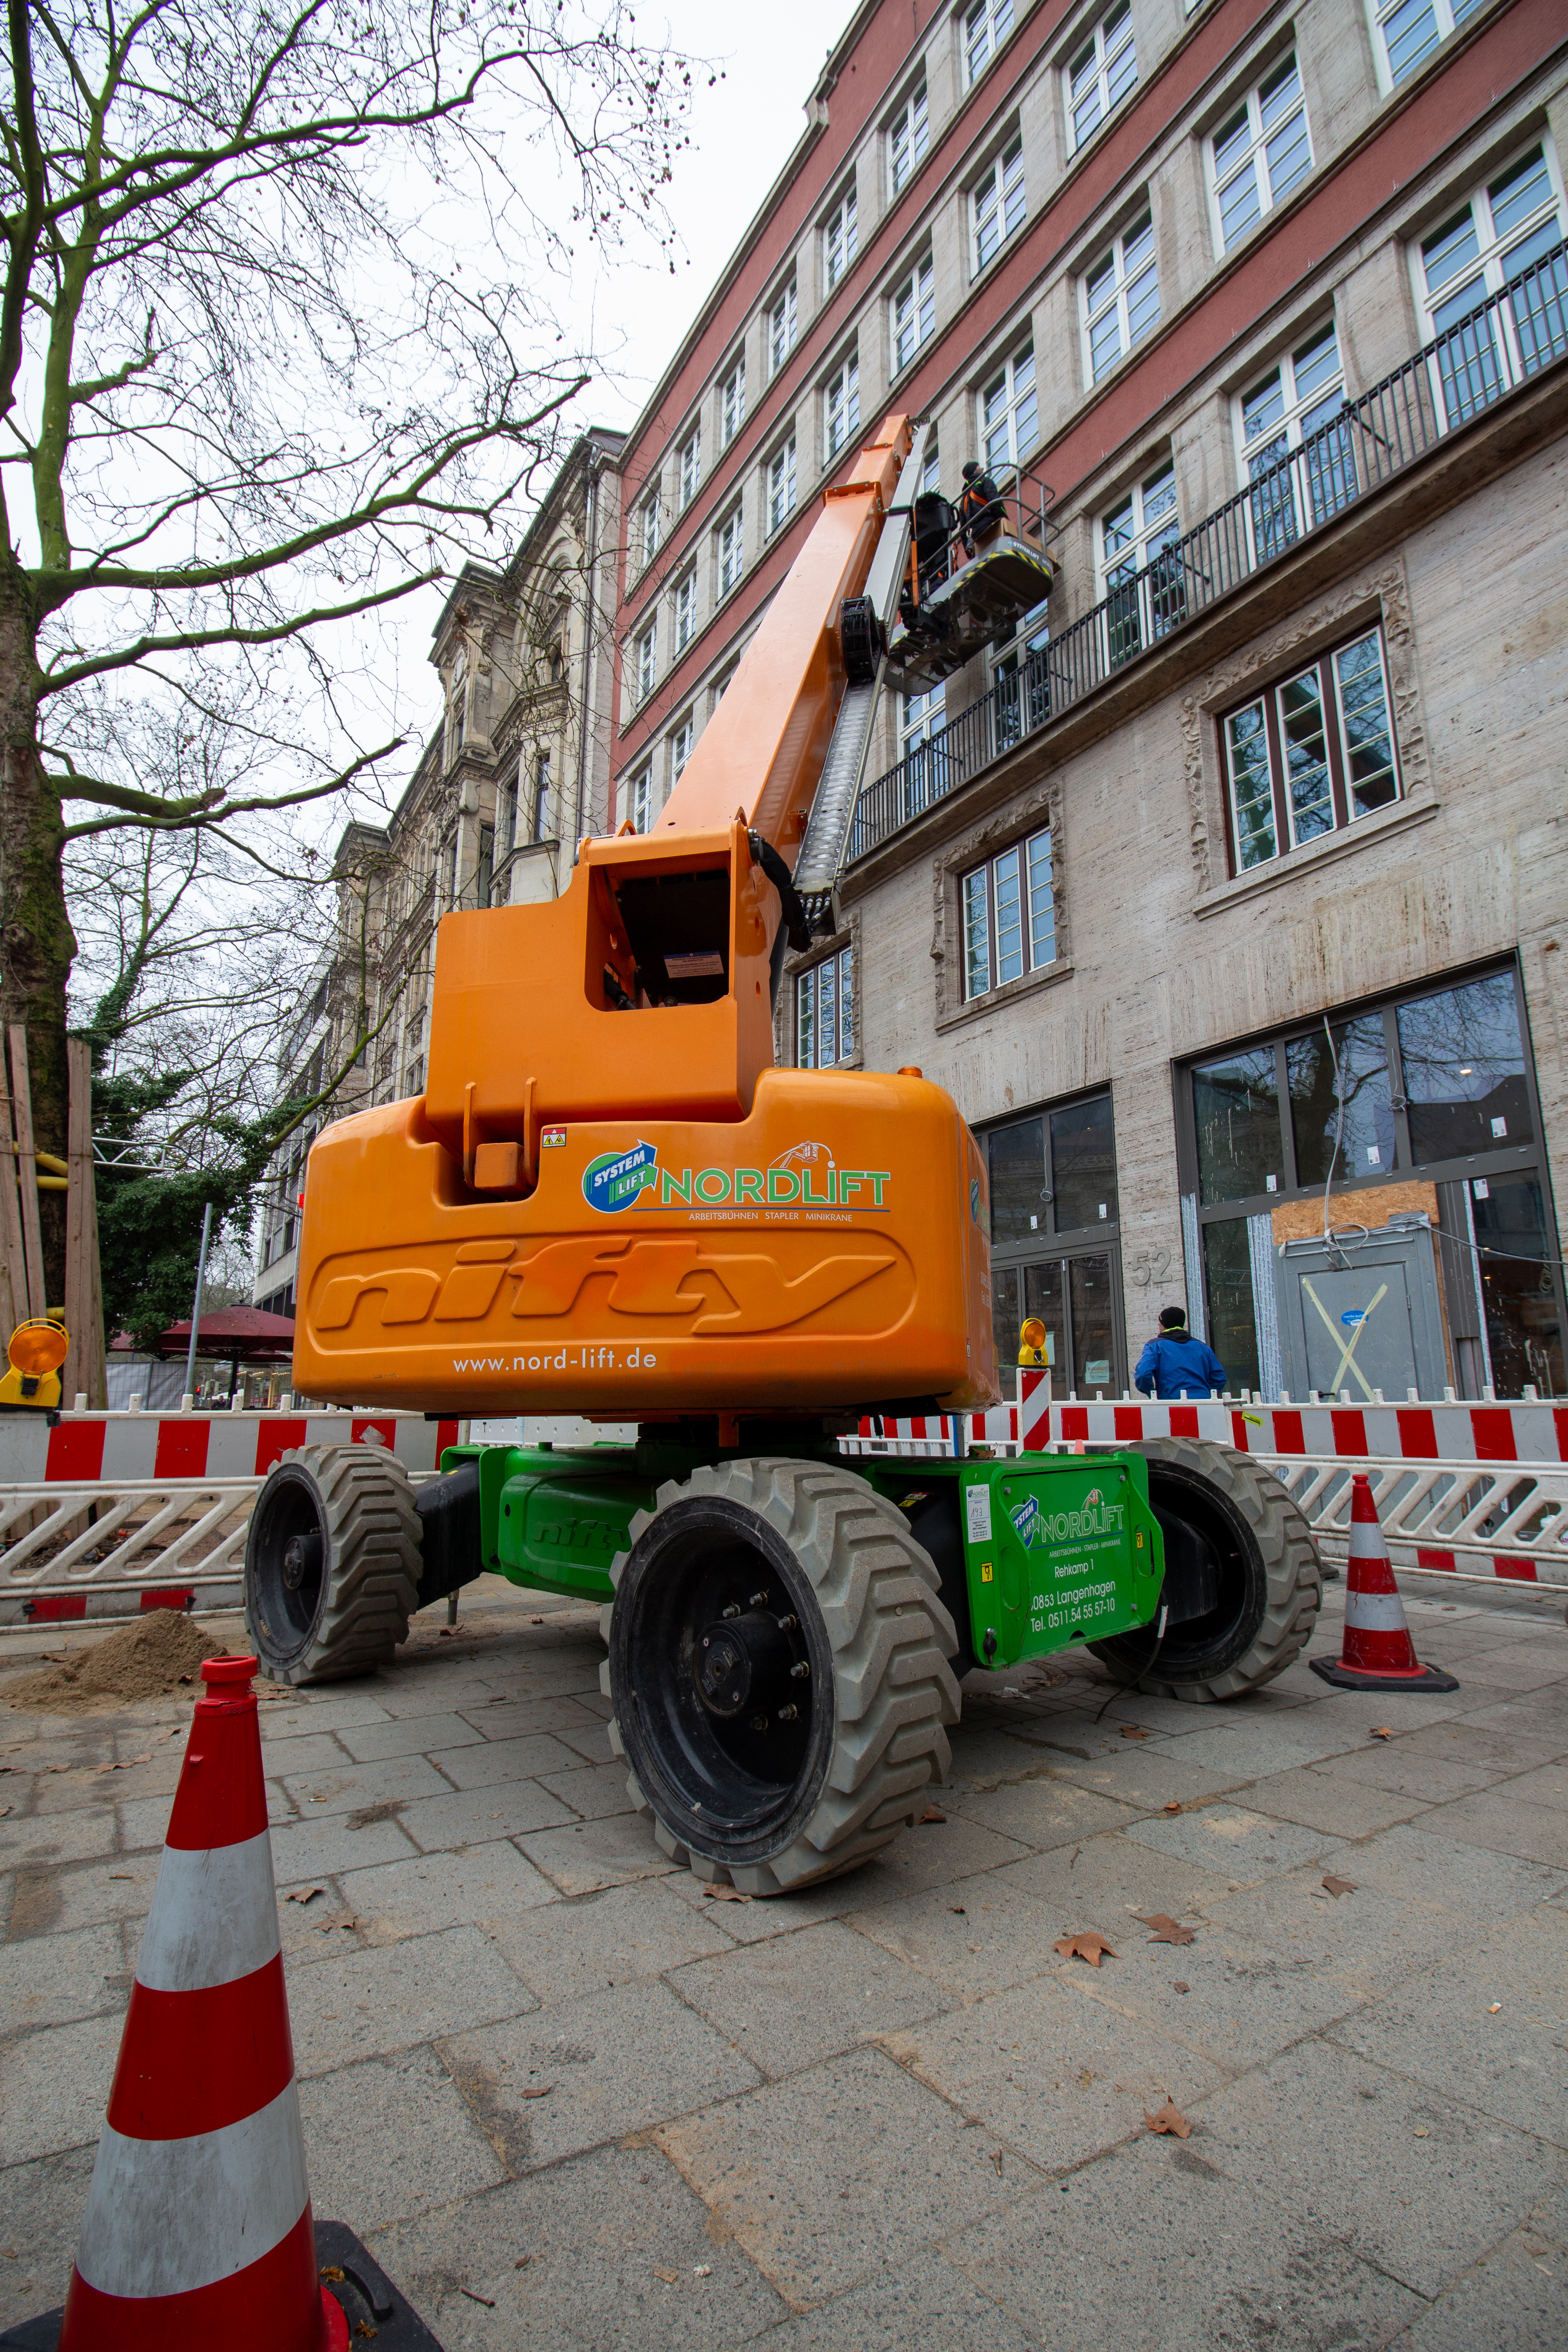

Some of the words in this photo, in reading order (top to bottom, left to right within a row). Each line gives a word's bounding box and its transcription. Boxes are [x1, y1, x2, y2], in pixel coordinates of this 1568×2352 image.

[593, 1150, 646, 1187] SYSTEM
[618, 1169, 646, 1196] LIFT
[662, 1167, 891, 1205] NORDLIFT
[689, 1210, 759, 1221] ARBEITSBÜHNEN
[765, 1212, 799, 1220] STAPLER
[805, 1212, 853, 1222] MINIKRANE
[1132, 1247, 1172, 1286] 52
[314, 1236, 897, 1334] nifty
[452, 1347, 657, 1373] www.nord-lift.de
[1013, 1502, 1034, 1529] YSTEM
[1023, 1517, 1035, 1538] LIFT
[1040, 1504, 1124, 1543] NORDLIFT
[1049, 1546, 1081, 1558] ARBEITSBÜHNEN
[1084, 1544, 1099, 1552] STAPLER
[1101, 1539, 1121, 1548] MINIKRANE
[1054, 1562, 1088, 1578] Rehkamp
[1090, 1558, 1094, 1570] 1
[1057, 1581, 1116, 1605] Langenhagen
[1030, 1616, 1046, 1632] Tel.
[1048, 1607, 1081, 1628] 0511.54
[1083, 1603, 1093, 1618] 55
[1095, 1597, 1115, 1616] 57-10
